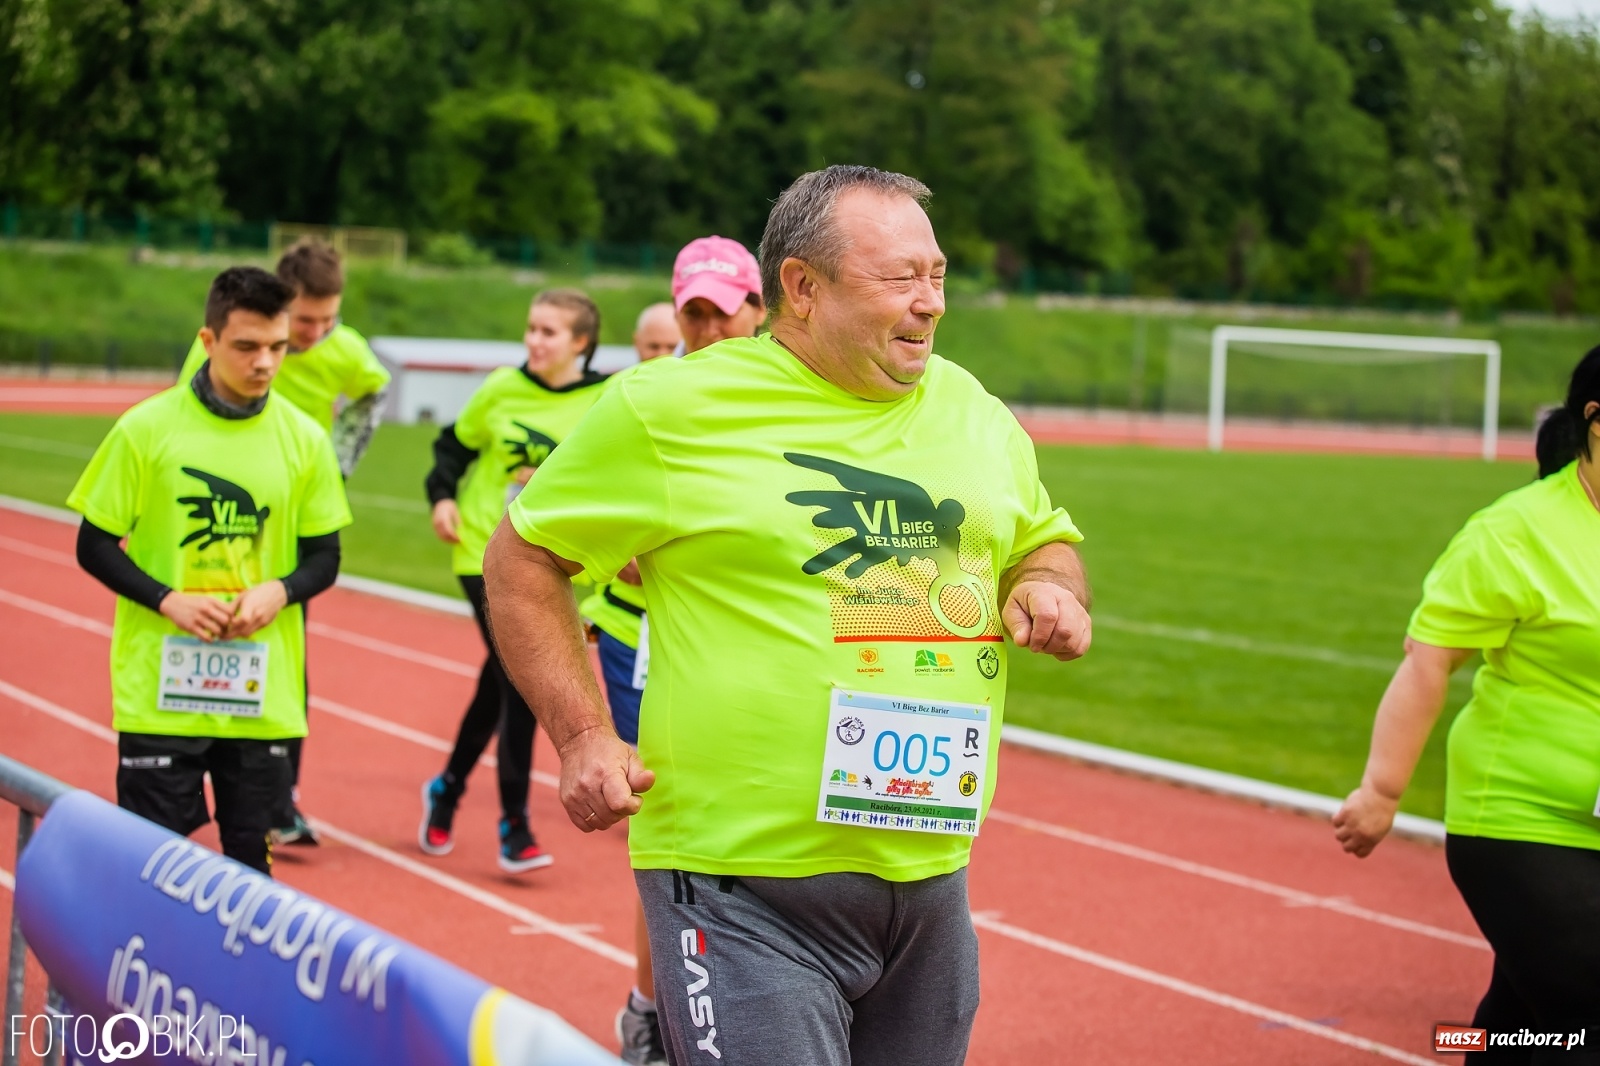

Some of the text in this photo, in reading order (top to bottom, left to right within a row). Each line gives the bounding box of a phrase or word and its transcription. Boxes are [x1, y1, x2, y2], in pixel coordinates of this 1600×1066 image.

[211, 500, 238, 525] VI
[853, 500, 934, 535] VI BIEG
[865, 535, 939, 549] BEZ BARIER
[843, 594, 920, 607] Wiśniewskiego
[875, 585, 904, 595] Jurka
[191, 653, 241, 679] 108
[892, 701, 950, 715] VI Bieg Bez Barier
[964, 727, 979, 749] R
[873, 730, 951, 777] 005
[870, 802, 903, 812] Racibórz,
[904, 806, 936, 815] 23.05.2021
[680, 928, 722, 1060] EASY
